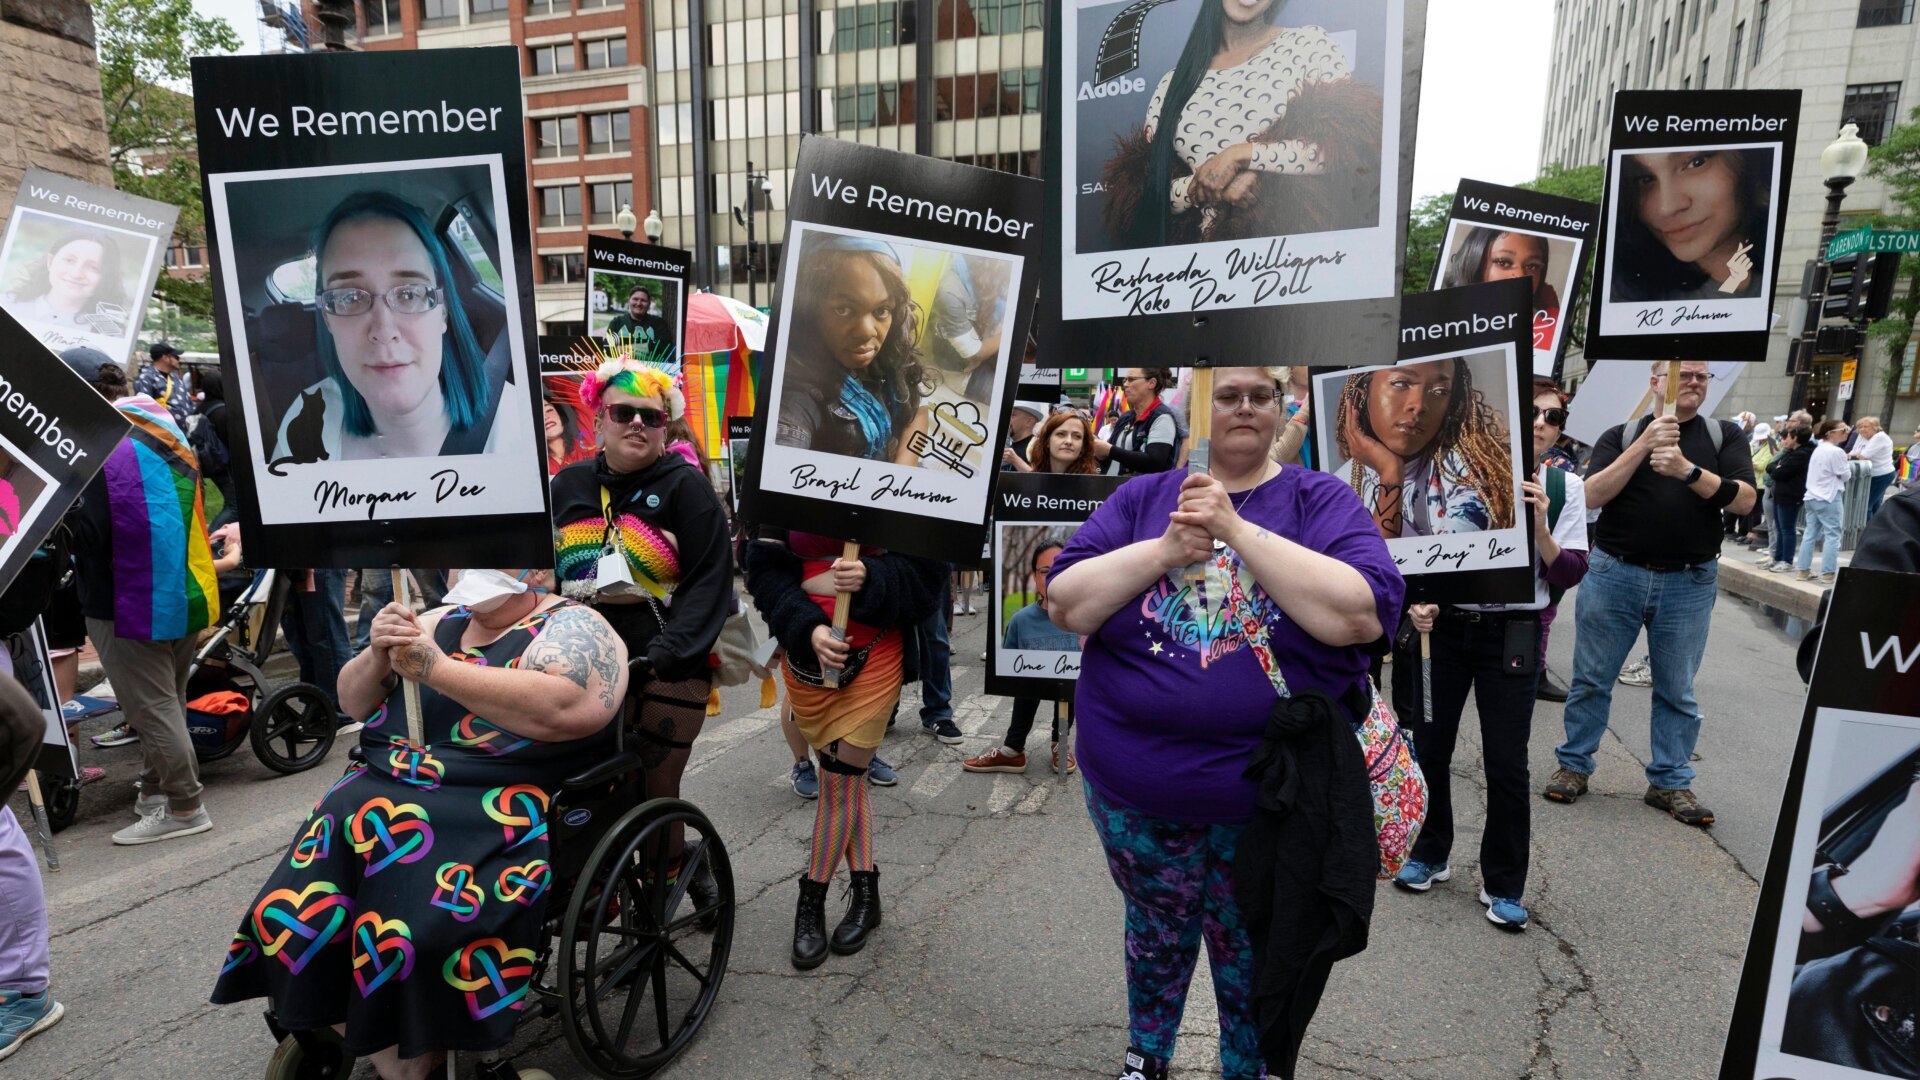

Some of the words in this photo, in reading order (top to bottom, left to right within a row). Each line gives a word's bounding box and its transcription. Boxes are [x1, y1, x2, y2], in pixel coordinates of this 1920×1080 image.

[1077, 76, 1146, 101] Adobe
[215, 107, 280, 138] We
[291, 100, 502, 136] Remember
[1624, 115, 1660, 132] We
[1665, 114, 1787, 132] Remember
[30, 185, 60, 203] We
[64, 194, 165, 230] Remember
[811, 173, 858, 204] We
[867, 185, 1034, 240] Remember
[1463, 196, 1490, 213] We
[1494, 202, 1590, 232] Remember
[1828, 231, 1865, 258] CLARENDON
[1869, 234, 1919, 250] LSTON
[594, 249, 615, 262] We
[618, 253, 685, 273] Remember
[1091, 252, 1211, 293] Rasheeda
[1226, 237, 1346, 280] Williams
[1122, 284, 1170, 316] Koko
[1189, 278, 1236, 311] Da
[1252, 262, 1312, 304] Doll
[1402, 313, 1518, 343] member
[1636, 307, 1663, 328] KC
[1671, 304, 1732, 326] Johnson
[314, 480, 417, 520] Morgan
[430, 469, 486, 503] Dee
[790, 464, 861, 498] Brazil
[871, 474, 958, 504] Johnson
[1003, 493, 1031, 508] We
[1488, 538, 1516, 560] Lee
